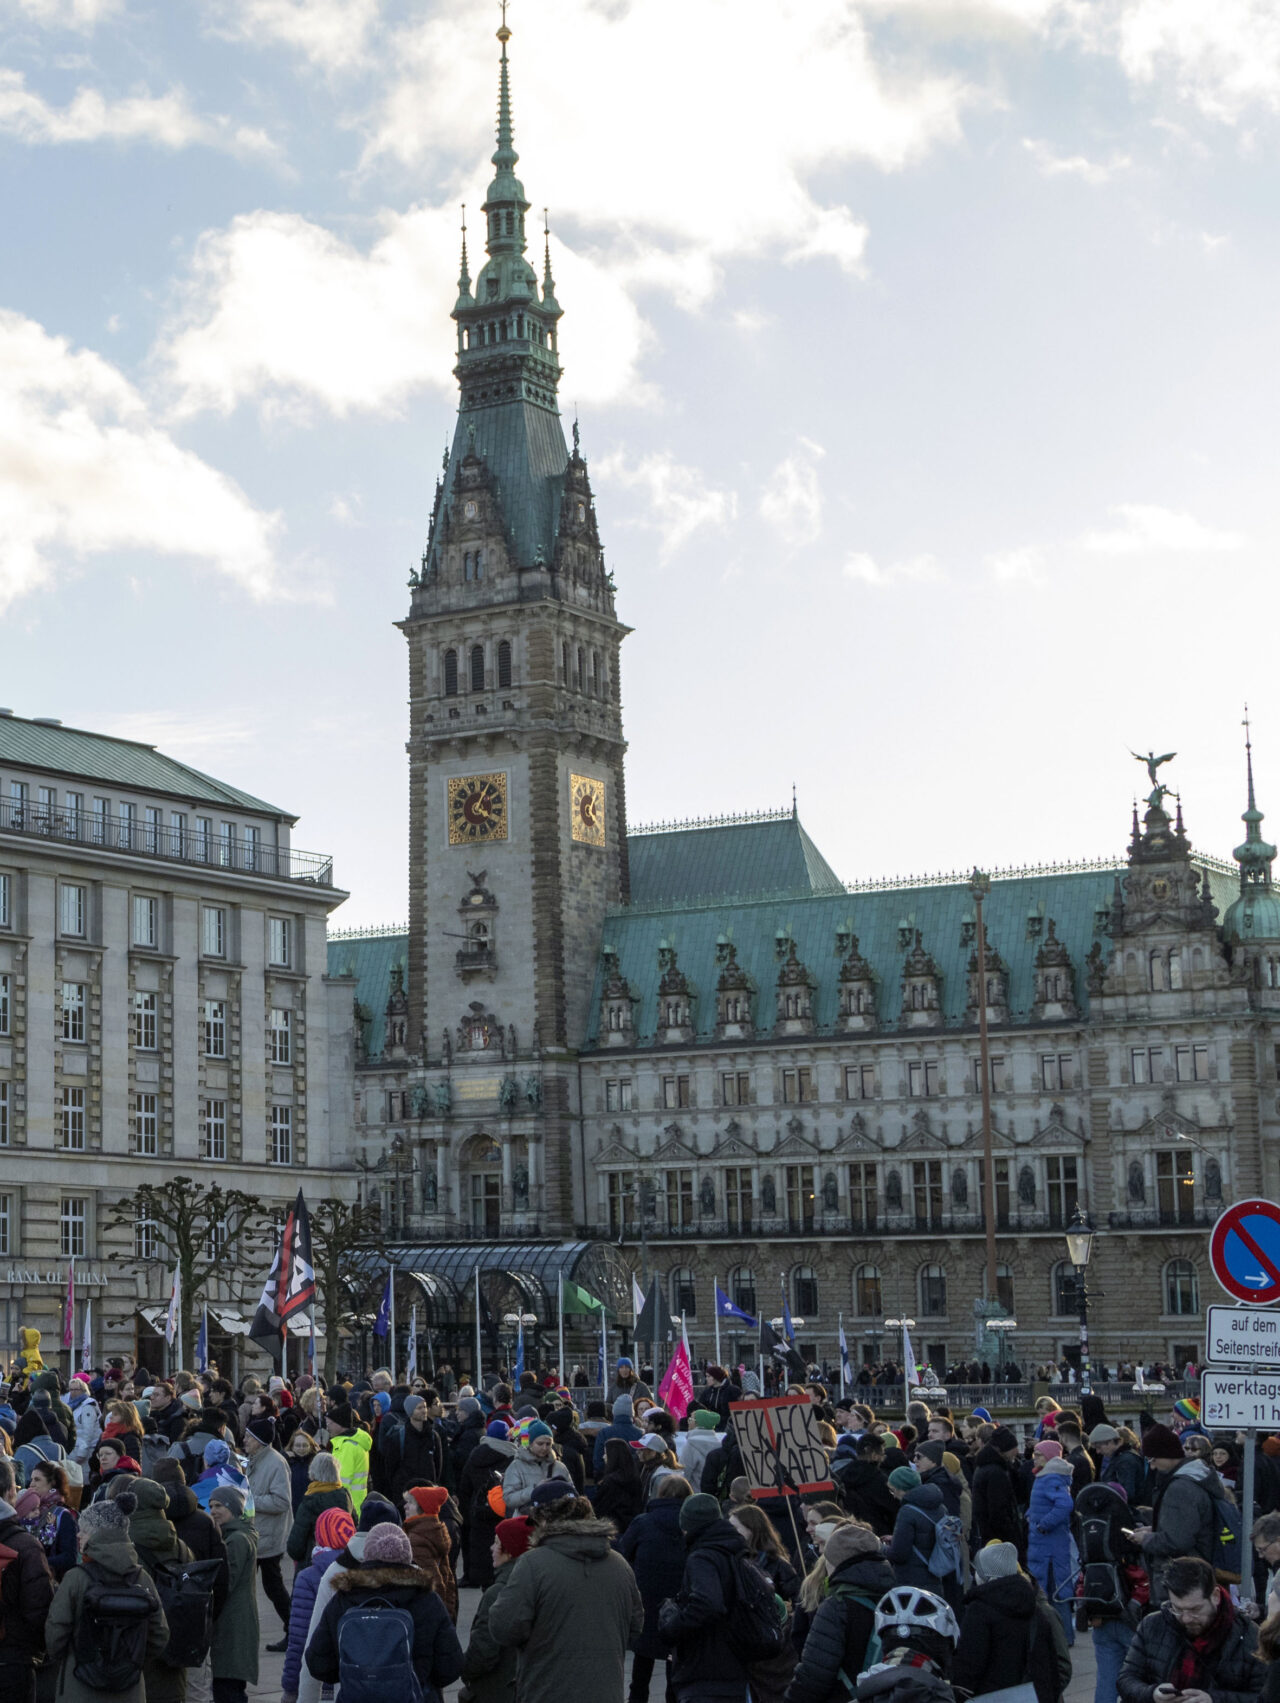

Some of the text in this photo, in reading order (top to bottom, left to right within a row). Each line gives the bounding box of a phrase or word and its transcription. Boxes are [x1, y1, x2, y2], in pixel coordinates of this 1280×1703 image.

[7, 1272, 108, 1286] BANK OF HINA
[1232, 1316, 1276, 1333] auf dem
[733, 1410, 772, 1450] FCK
[775, 1404, 822, 1449] FCK
[1253, 1404, 1265, 1420] 11
[742, 1449, 778, 1487] NZS
[787, 1447, 829, 1484] AFD
